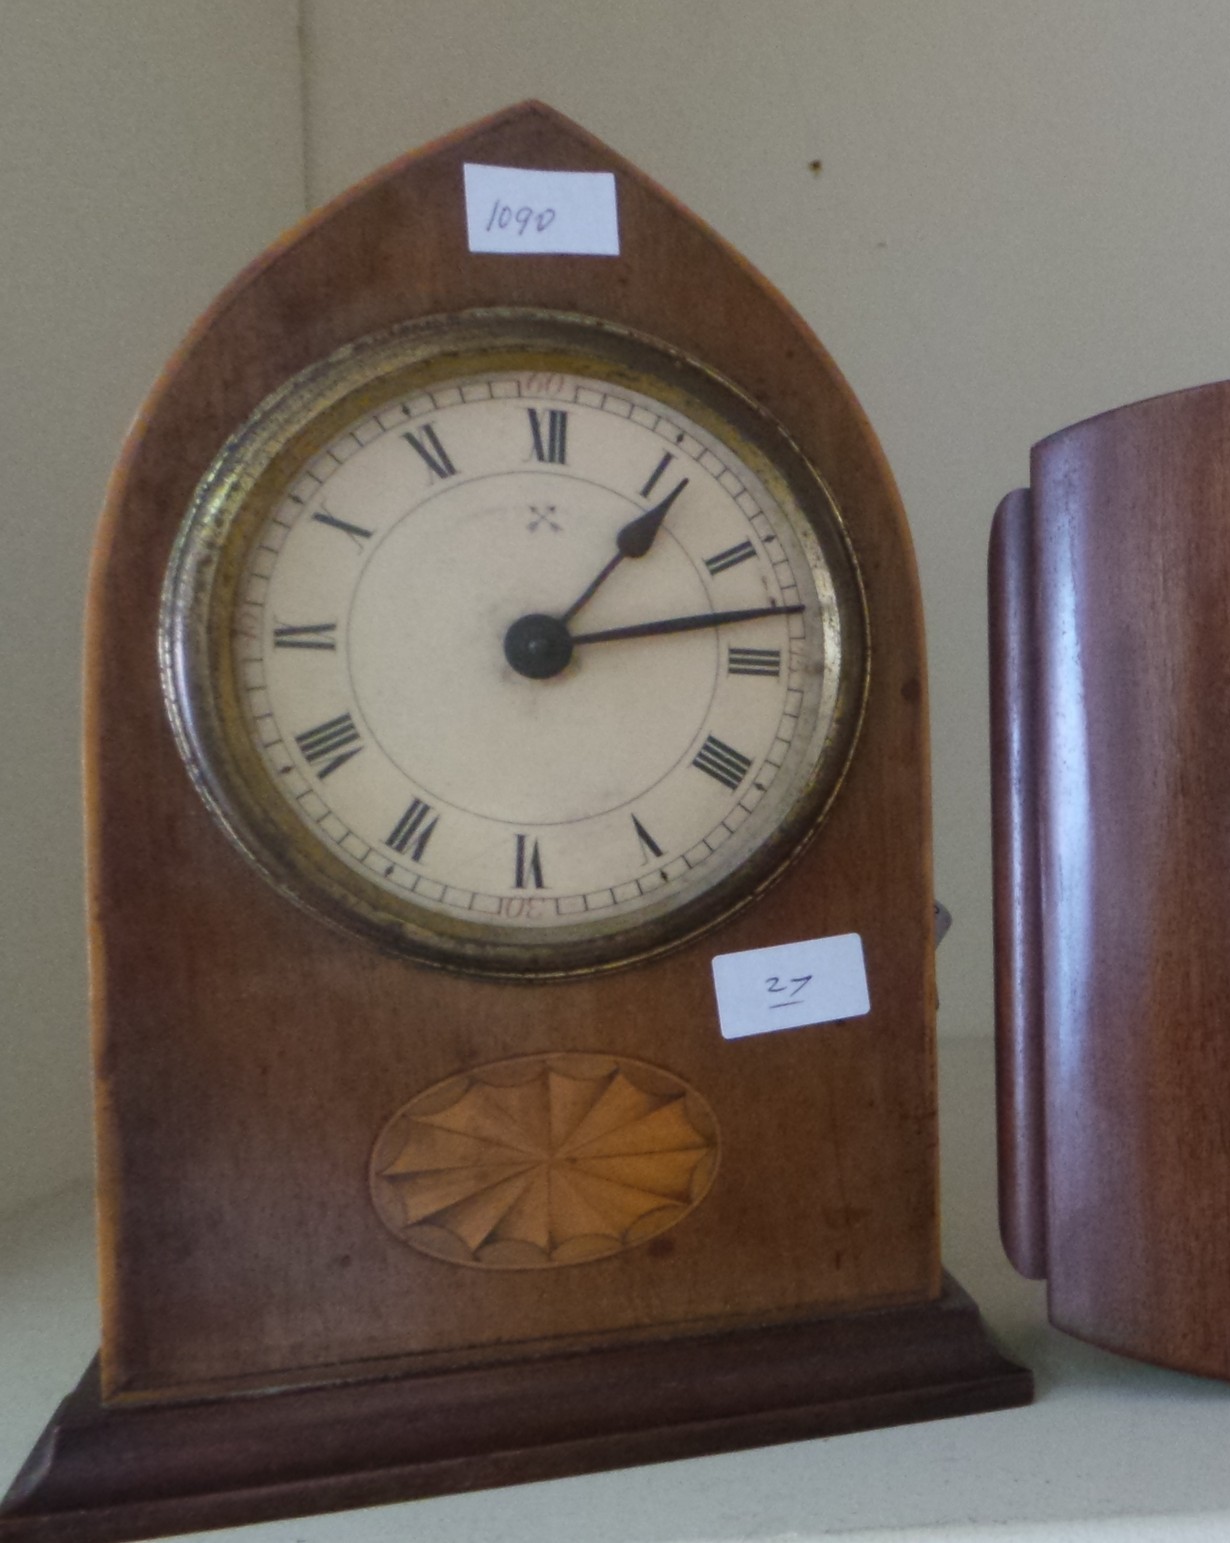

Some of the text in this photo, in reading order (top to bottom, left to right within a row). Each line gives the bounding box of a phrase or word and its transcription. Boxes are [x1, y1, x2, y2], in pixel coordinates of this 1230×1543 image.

[486, 200, 556, 236] 1090
[400, 420, 461, 486] XI
[521, 406, 571, 467] XII
[312, 497, 377, 556] X
[701, 535, 759, 579] II
[272, 613, 338, 653] IX
[726, 643, 783, 684] III
[294, 712, 366, 784] VIII
[688, 730, 756, 795] IIII
[381, 795, 441, 865] VII
[630, 812, 668, 867] V
[511, 833, 553, 890] VI
[765, 974, 813, 998] 27
